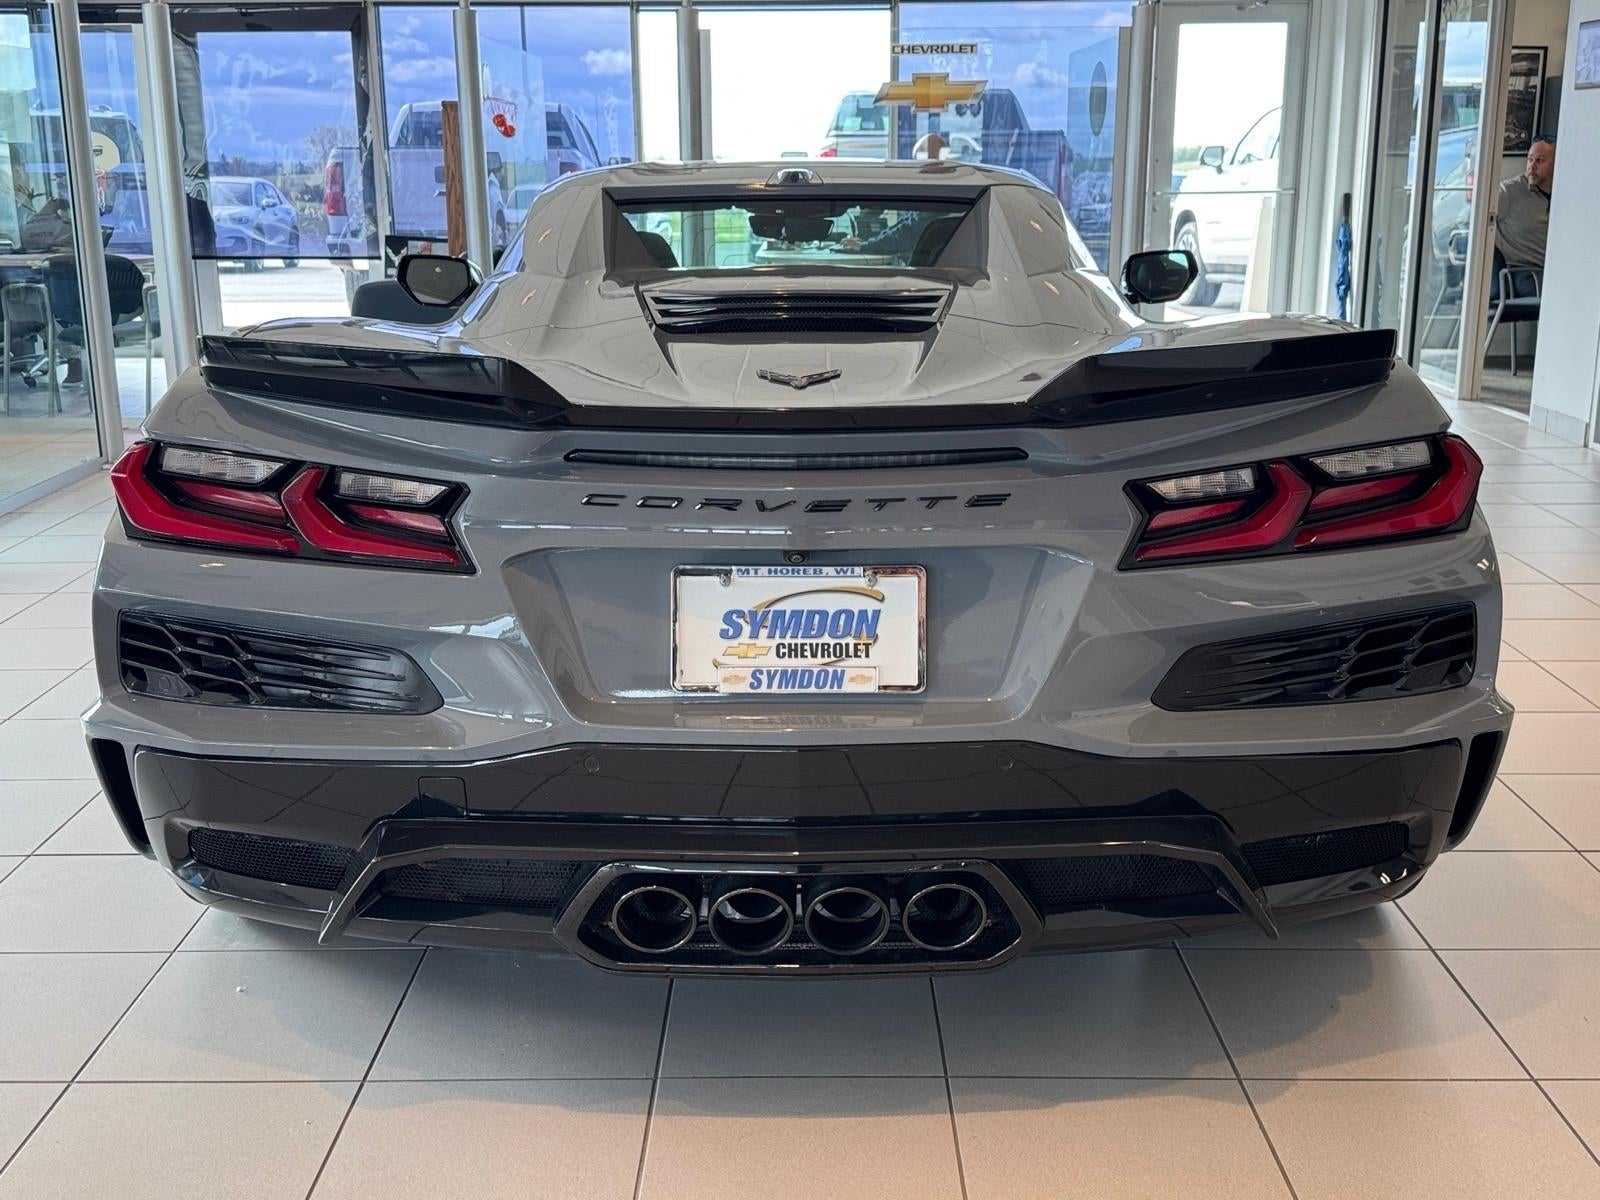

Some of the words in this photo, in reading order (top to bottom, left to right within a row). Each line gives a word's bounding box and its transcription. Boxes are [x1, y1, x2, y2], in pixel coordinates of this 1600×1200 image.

[892, 44, 976, 54] CHEVROLET
[581, 493, 1012, 513] CORVETTE
[719, 608, 881, 639] SYMDON
[775, 642, 872, 659] CHEVROLET
[749, 668, 846, 690] SYMDON
